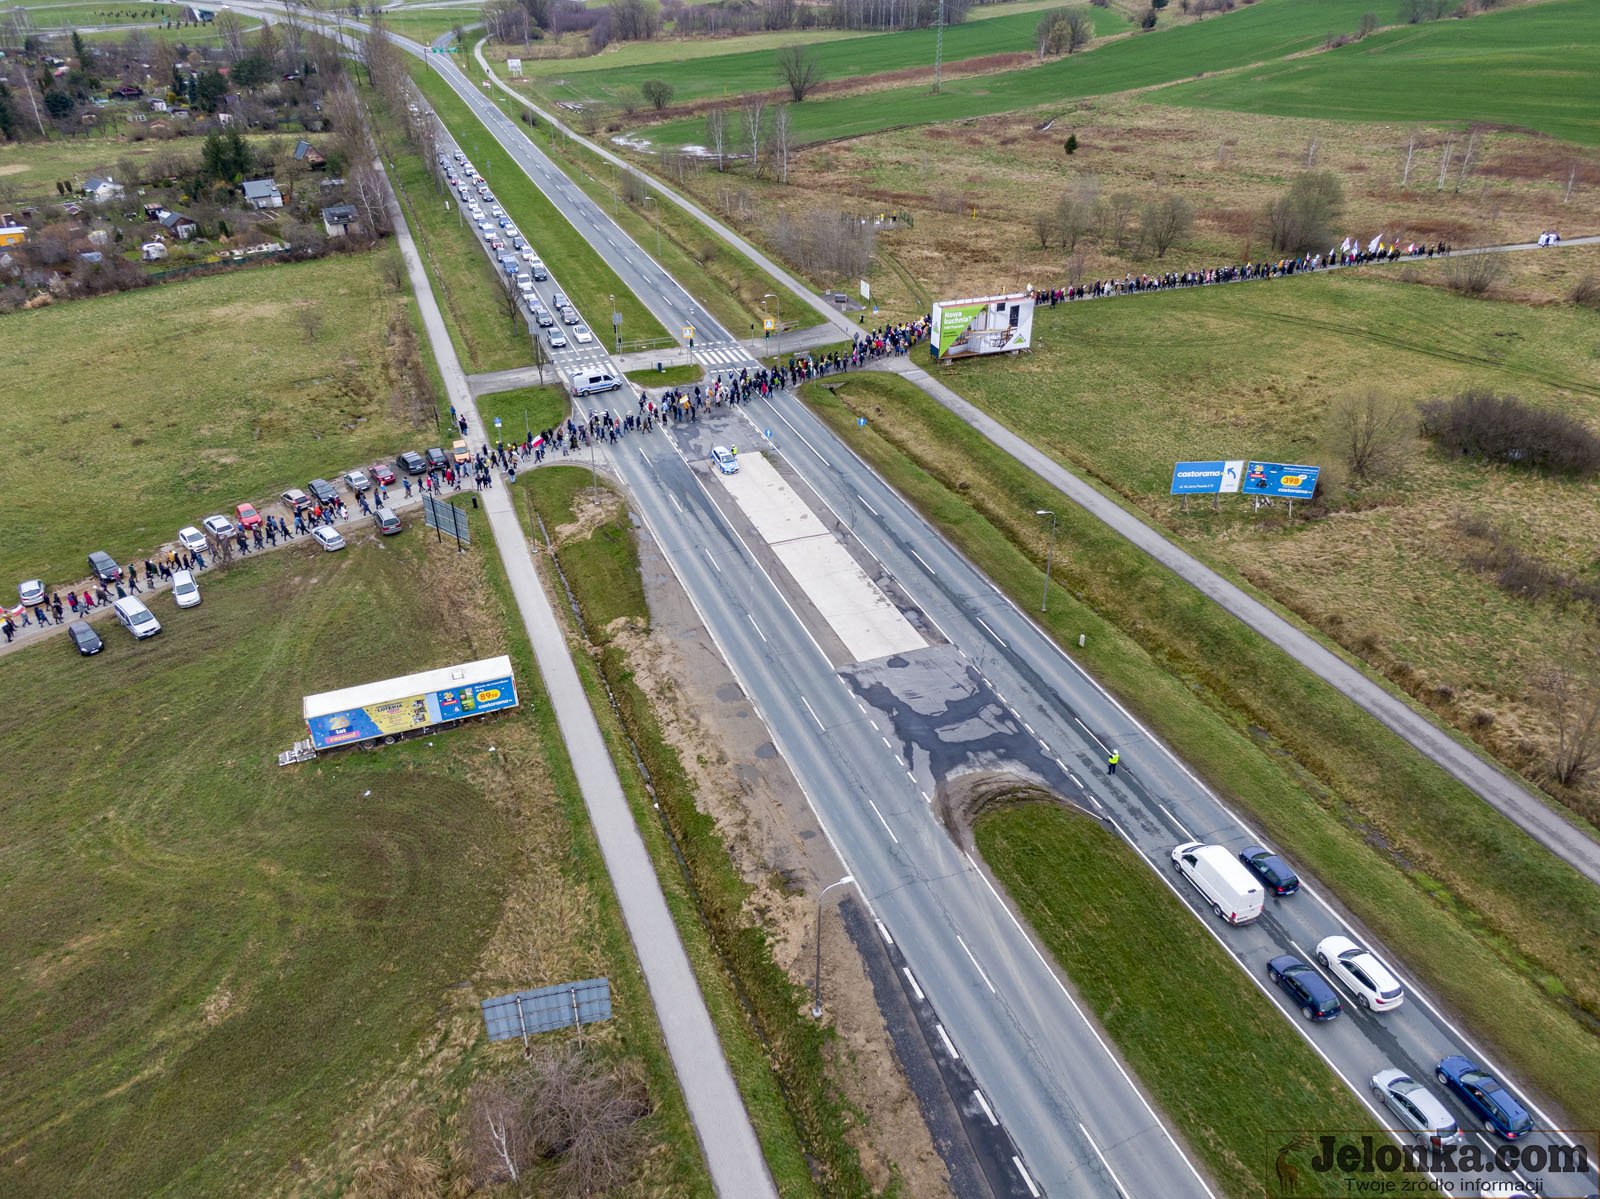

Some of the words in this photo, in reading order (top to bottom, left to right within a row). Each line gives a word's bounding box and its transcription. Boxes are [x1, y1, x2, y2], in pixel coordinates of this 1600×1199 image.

[944, 311, 962, 319] Nowa
[1283, 477, 1300, 485] 398
[377, 703, 403, 712] LOTERIA
[478, 699, 508, 709] castorama
[330, 732, 356, 742] razem!
